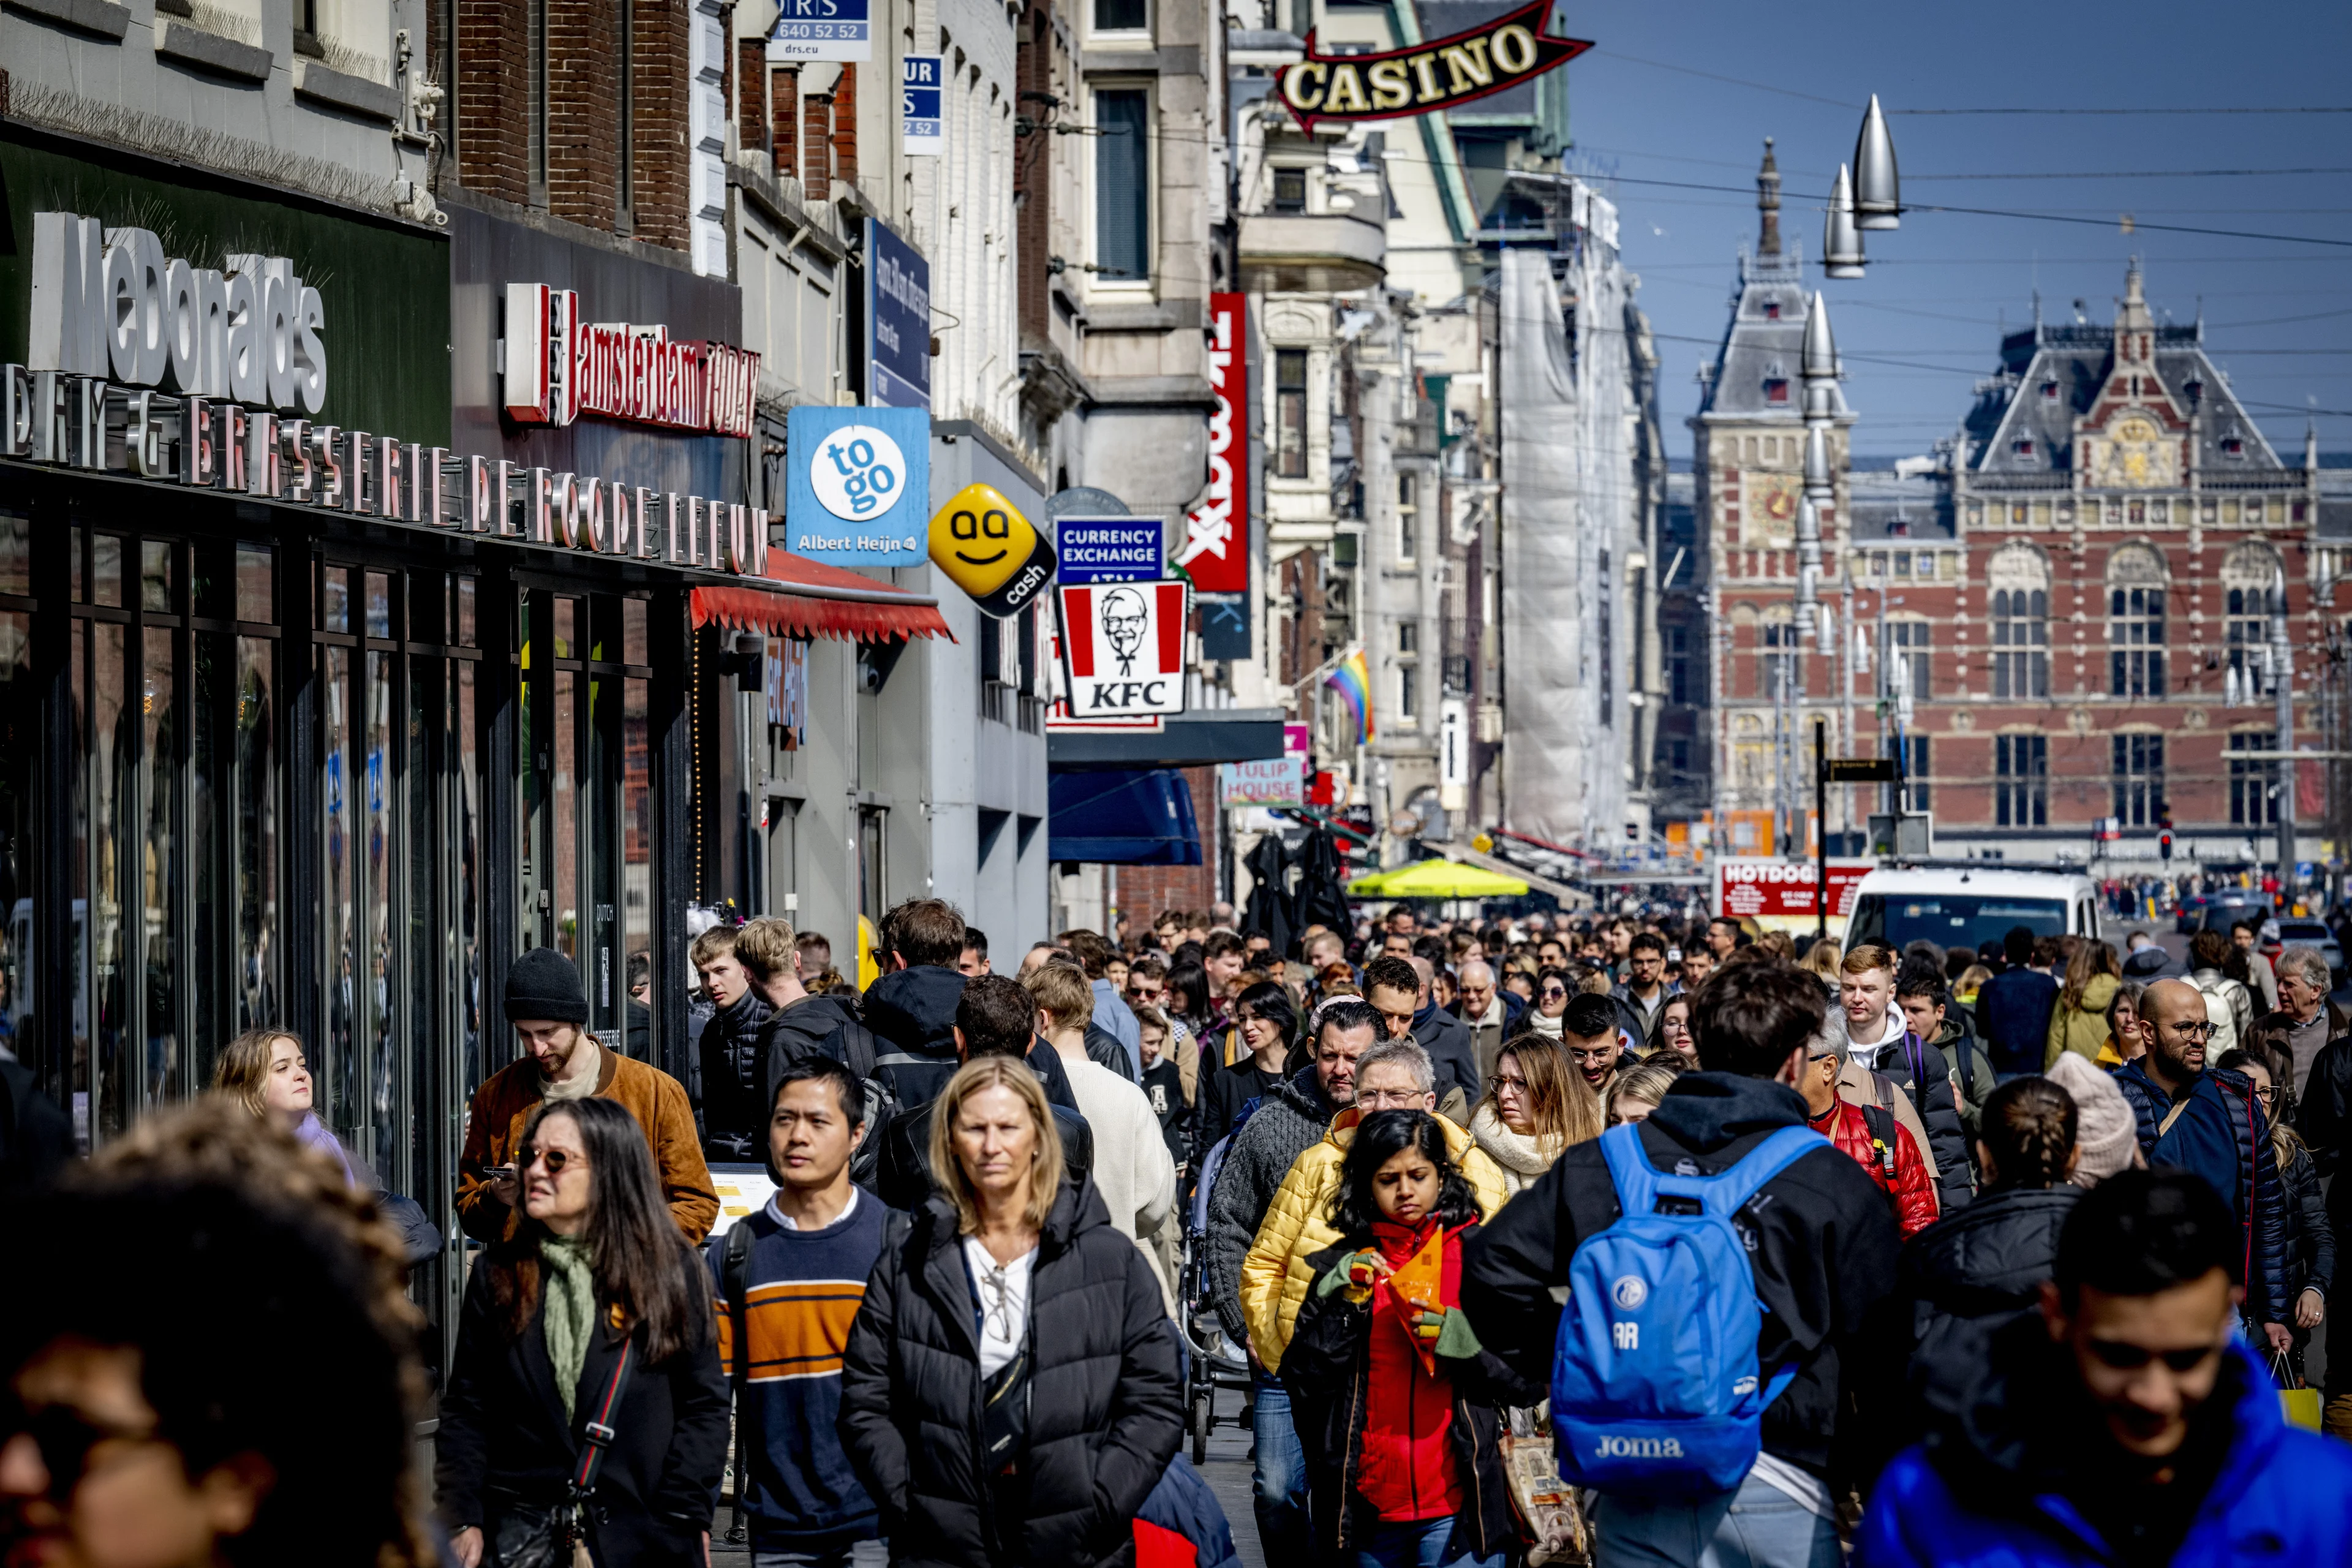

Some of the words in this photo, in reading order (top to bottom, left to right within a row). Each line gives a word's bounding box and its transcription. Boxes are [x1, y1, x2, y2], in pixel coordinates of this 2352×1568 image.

[780, 24, 810, 38] 640
[815, 25, 833, 38] 52
[839, 25, 858, 39] 52
[785, 43, 819, 55] drs.eu
[1284, 23, 1538, 113] CASINO
[916, 123, 932, 135] 52
[29, 211, 327, 414] McDonald's
[579, 322, 700, 428] amsterdam
[704, 342, 761, 439] TODAY
[827, 439, 875, 476] to
[0, 363, 108, 470] DAM
[126, 390, 163, 477] &
[179, 398, 450, 525] BRASSERIE
[462, 455, 516, 537] DE
[526, 467, 653, 559] ROODE
[660, 492, 768, 576] LEEUW
[843, 464, 895, 514] go
[798, 535, 851, 551] Albert
[857, 535, 900, 554] Heijn
[1063, 529, 1156, 545] CURRENCY
[1063, 548, 1156, 562] EXCHANGE
[1006, 565, 1047, 605] cash
[1090, 680, 1166, 709] KFC
[1234, 762, 1290, 778] TULIP
[1227, 780, 1296, 798] HOUSE
[597, 904, 613, 921] DUTCH
[593, 1030, 620, 1047] RASSERIE
[1594, 1435, 1684, 1458] Joma
